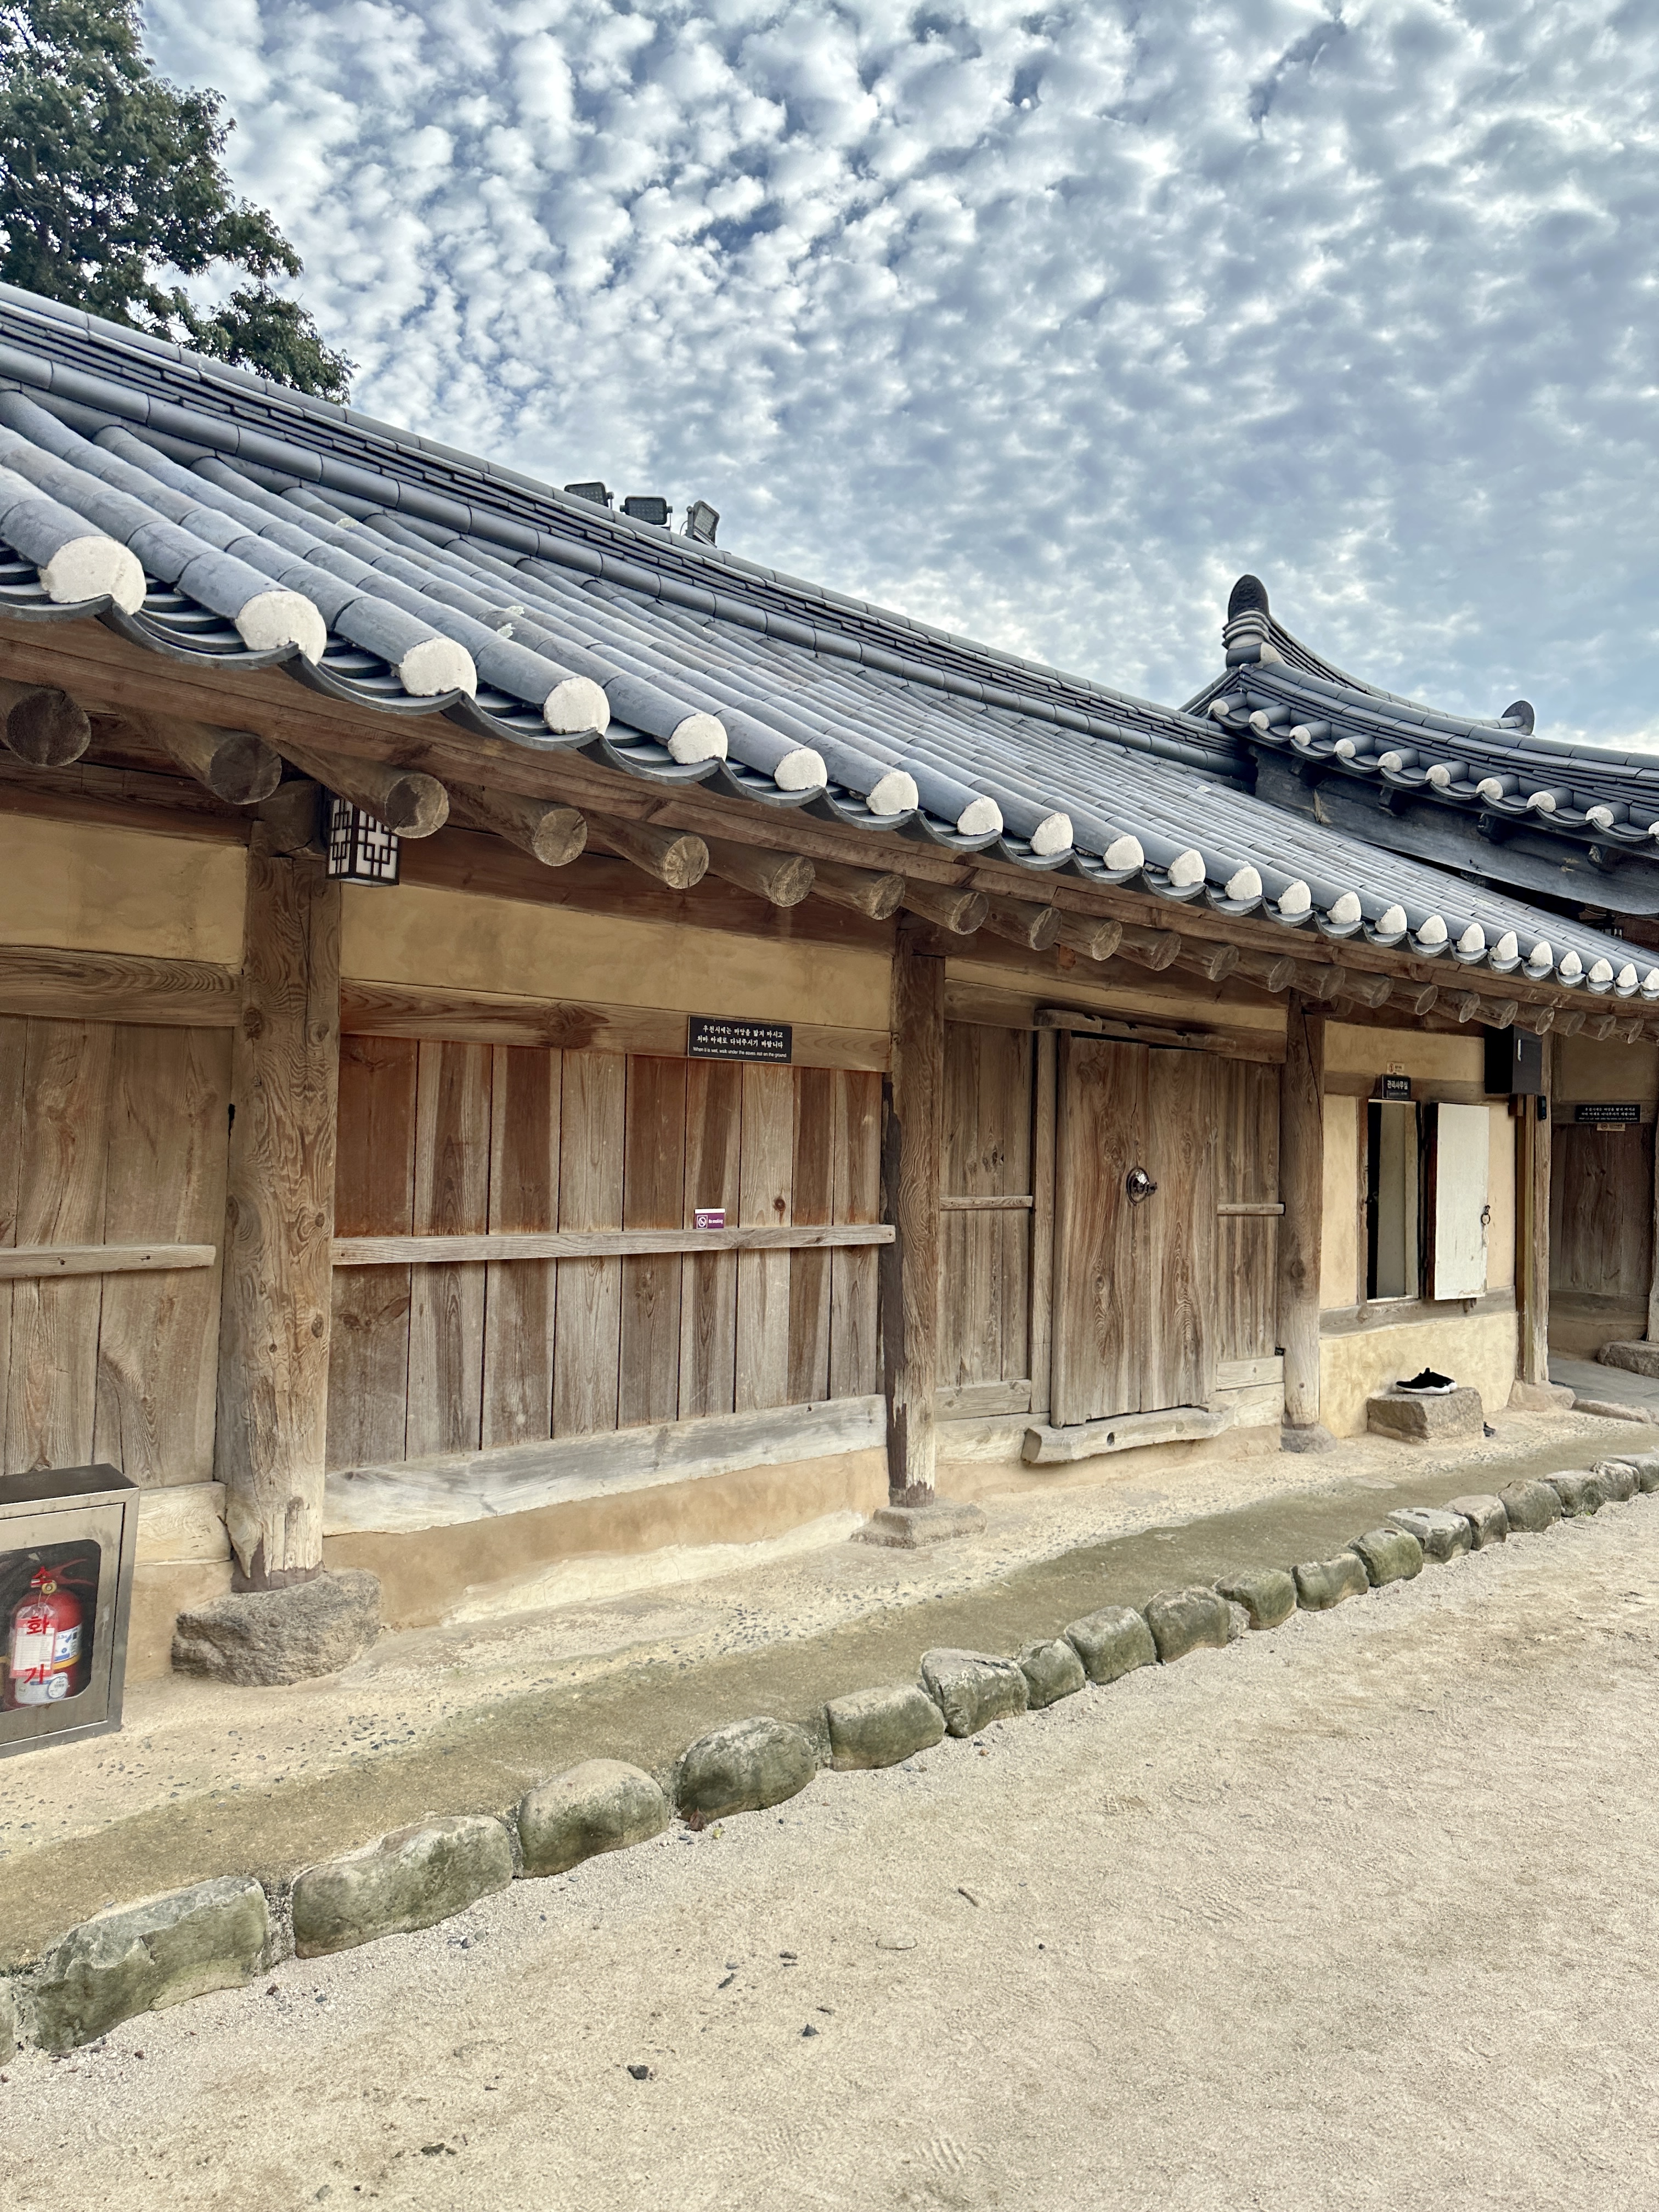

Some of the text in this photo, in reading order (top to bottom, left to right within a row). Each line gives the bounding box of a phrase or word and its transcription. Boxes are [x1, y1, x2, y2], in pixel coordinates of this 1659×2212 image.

[703, 1025, 783, 1039] 우천시에는 마당을 밟지 마시고
[696, 1035, 708, 1043] 처마
[710, 1035, 728, 1044] 아래로
[761, 1040, 783, 1048] 바랍니다
